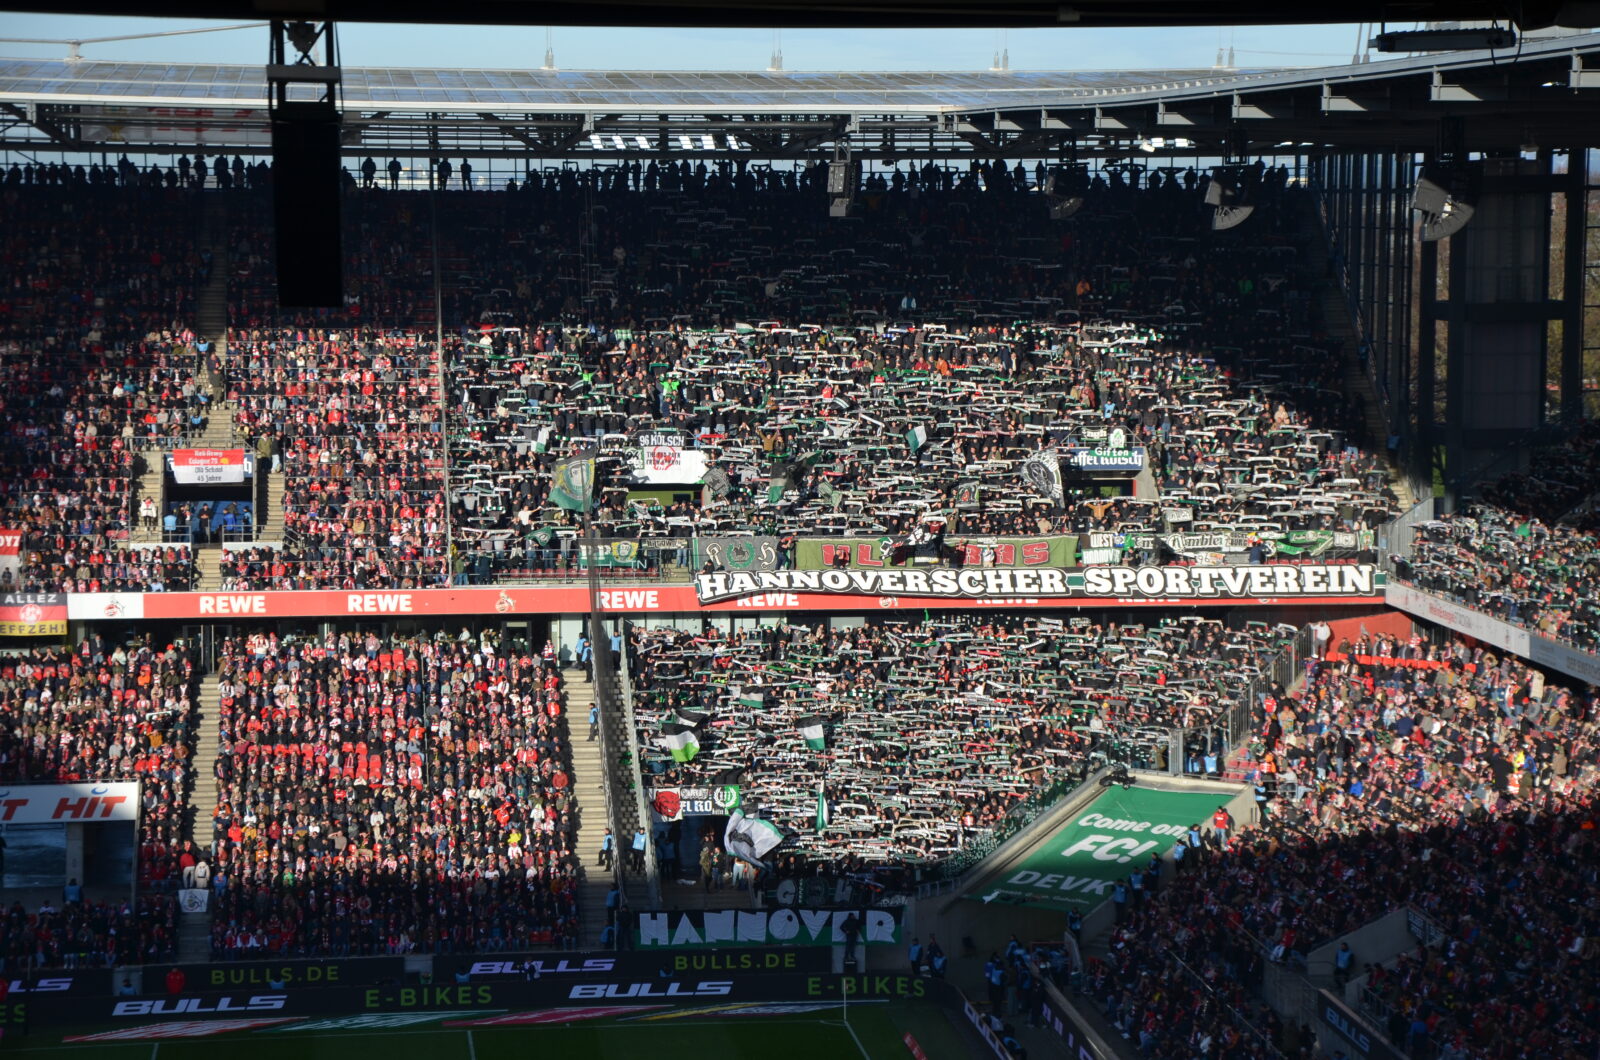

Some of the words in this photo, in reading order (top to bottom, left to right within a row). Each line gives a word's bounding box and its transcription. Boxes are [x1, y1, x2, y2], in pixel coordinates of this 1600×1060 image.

[639, 434, 650, 447] 96
[651, 432, 685, 447] KÖLSCH
[1090, 533, 1114, 548] WEST
[699, 567, 1067, 600] HANNOVERSCHER
[1084, 564, 1374, 594] SPORTVEREIN
[4, 594, 57, 604] ALLEZ
[199, 595, 267, 613] REWE
[347, 594, 413, 612] REWE
[595, 590, 659, 609] REWE
[0, 624, 65, 635] EFFZEH!
[51, 796, 127, 819] HIT
[1077, 812, 1152, 832] Come
[1060, 834, 1159, 864] FC!
[1007, 870, 1115, 896] DEVK
[639, 908, 896, 946] HANNOVER
[470, 958, 616, 976] BULLS
[674, 953, 797, 971] BULLS.DE
[210, 965, 340, 985] BULLS.DE
[365, 985, 494, 1008] E-BIKES
[568, 981, 734, 999] BULLS
[807, 975, 926, 998] E-BIKES
[112, 994, 288, 1016] BULLS
[1325, 1006, 1371, 1053] BULLS
